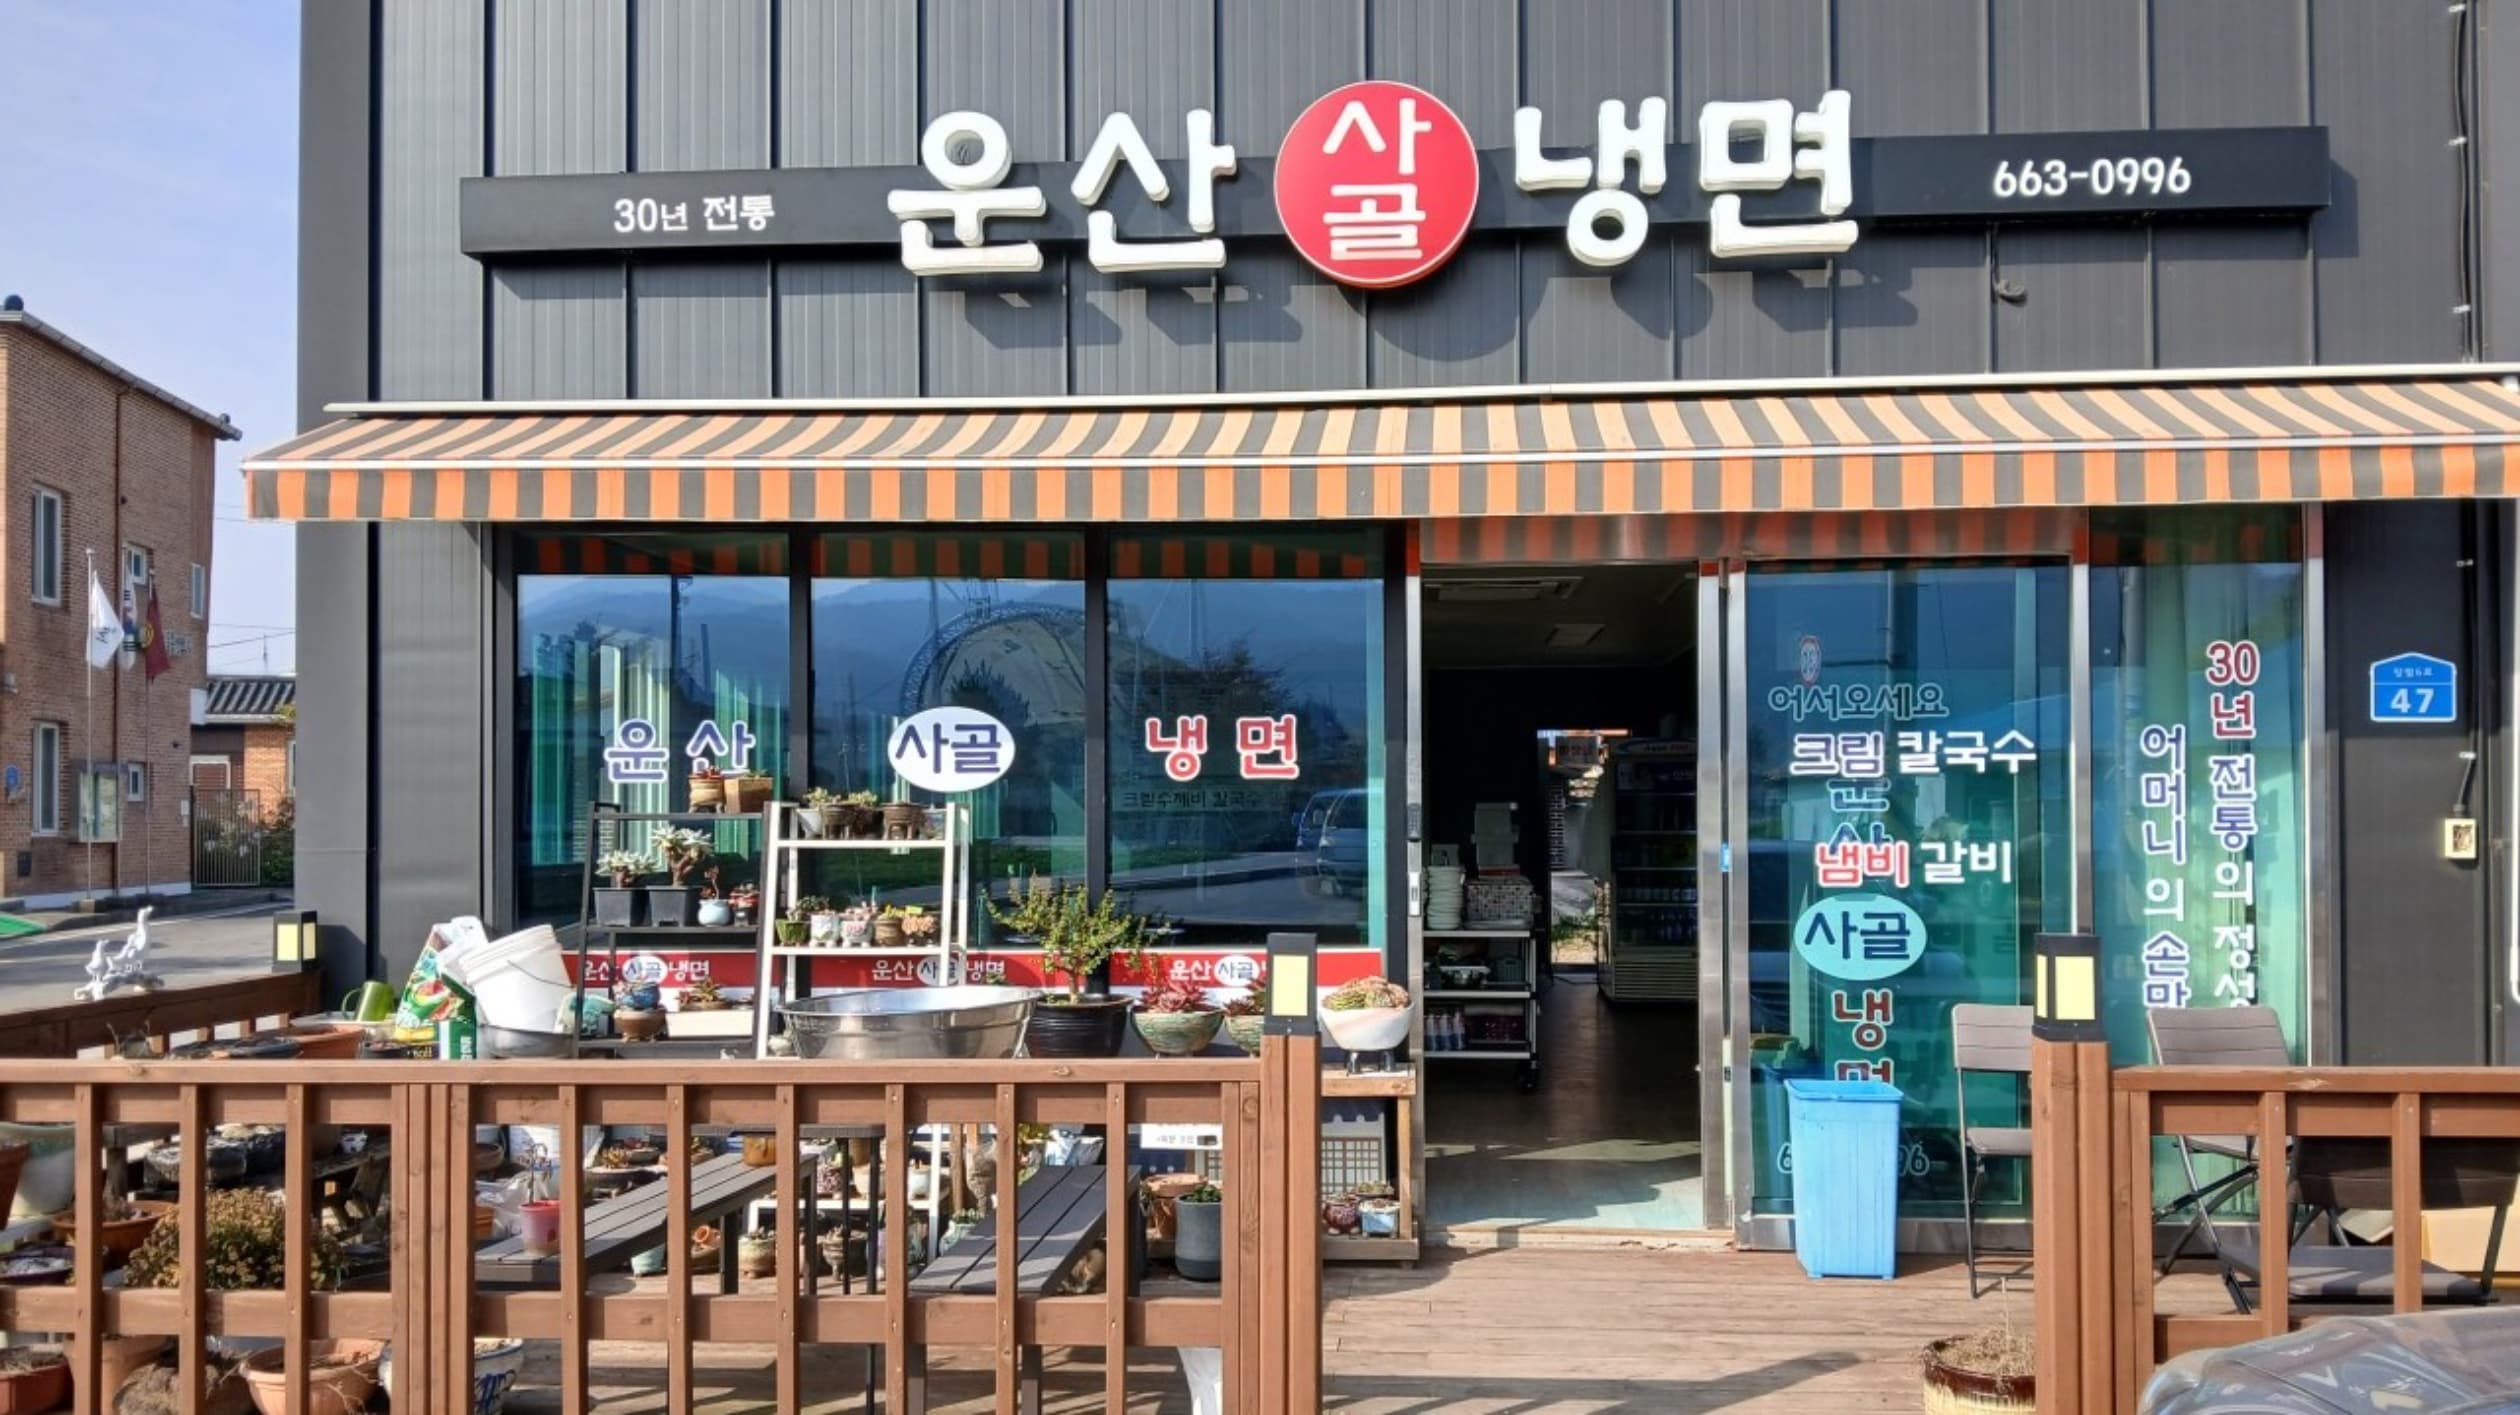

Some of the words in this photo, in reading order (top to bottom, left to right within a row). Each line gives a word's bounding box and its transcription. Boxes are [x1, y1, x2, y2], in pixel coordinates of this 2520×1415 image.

[888, 109, 1237, 277] 운산
[1322, 98, 1431, 261] 사골
[1513, 90, 1858, 269] 냉면
[1993, 156, 2192, 199] 663-0996
[614, 198, 689, 233] 30년
[702, 195, 776, 232] 전통
[1767, 683, 1950, 722] 어서오세요
[2389, 687, 2436, 714] 47
[604, 717, 757, 783] 운산
[893, 721, 1002, 776] 사골
[1145, 714, 1301, 783] 냉면
[1790, 731, 1886, 778] 크림
[1898, 728, 2037, 774] 칼국수
[1815, 839, 1911, 889] 냄비
[1920, 839, 2013, 885] 갈비
[1803, 910, 1911, 961] 사골
[668, 959, 709, 982] 냉면
[872, 960, 914, 982] 운산
[1169, 960, 1212, 982] 운산
[1217, 961, 1254, 980] 사골
